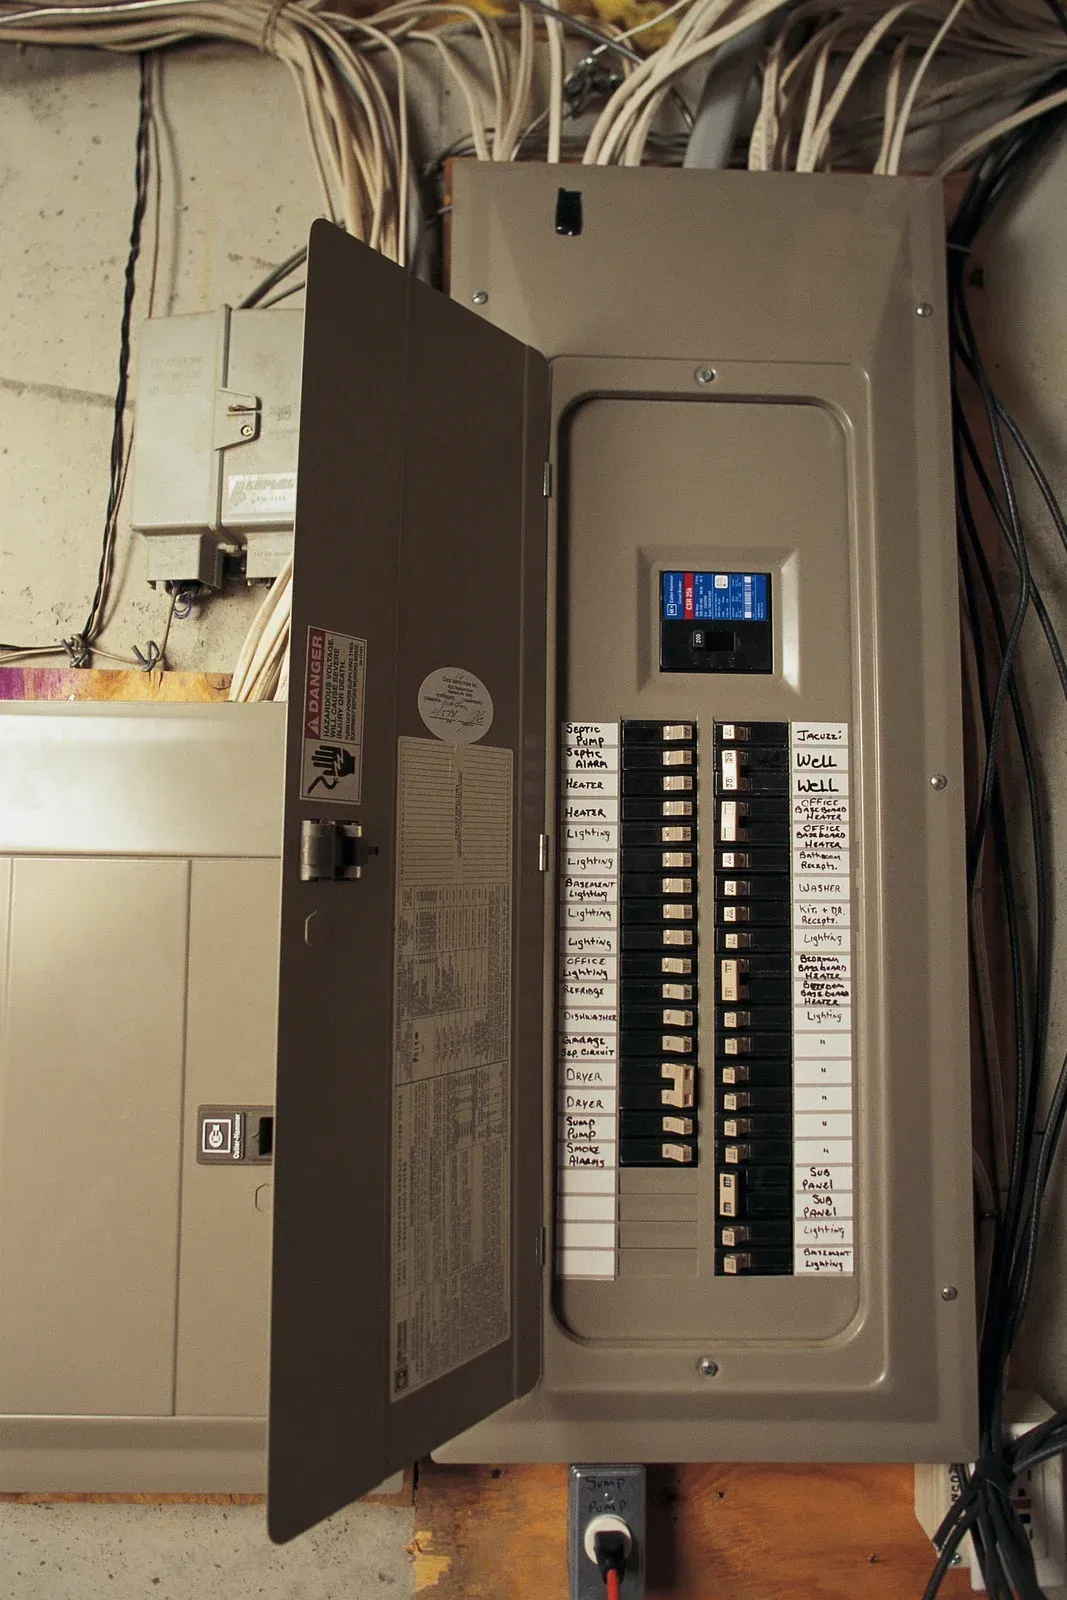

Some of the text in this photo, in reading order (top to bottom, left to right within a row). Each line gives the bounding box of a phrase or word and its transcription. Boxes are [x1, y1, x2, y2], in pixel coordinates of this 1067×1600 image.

[685, 598, 693, 610] CSR
[332, 647, 340, 683] SEVERE
[308, 635, 323, 713] DANGER
[323, 637, 334, 737] HAZARDOUS VOLTAGE.
[338, 693, 344, 706] OR
[576, 736, 604, 748] PUMP
[726, 752, 732, 762] 20
[797, 752, 837, 768] Well
[575, 759, 608, 769] ALARM
[565, 777, 604, 790] HEATER
[727, 778, 733, 788] 20
[798, 778, 839, 792] Well
[801, 797, 838, 807] OFFICE
[565, 807, 606, 818] HEATER
[806, 813, 842, 821] HEATER
[803, 824, 841, 832] OFFICE
[567, 828, 610, 841] Lighting
[804, 840, 842, 849] HEATER
[567, 856, 614, 870] Lighting
[565, 878, 616, 888] BASEMENT
[799, 883, 841, 893] WASHER
[569, 889, 608, 901] Lighting
[567, 907, 612, 921] Lighting
[568, 936, 612, 951] Lighting
[804, 932, 842, 947] Lighting
[566, 957, 606, 966] OFFICE
[562, 967, 608, 981] Lighting
[805, 972, 842, 980] HEATER
[804, 997, 840, 1006] HEATER
[563, 1011, 617, 1021] DISHWASHER
[807, 1010, 842, 1023] Lighting
[562, 1036, 606, 1048] GARAGE
[581, 1047, 615, 1056] CIRCUIT
[566, 1067, 602, 1083] DRYER
[566, 1096, 604, 1109] DRYER
[566, 1116, 596, 1130] SUMP
[567, 1128, 596, 1141] PUMP
[566, 1142, 600, 1154] SMOKE
[568, 1155, 605, 1167] ALARMS
[810, 1167, 831, 1177] SUB
[802, 1179, 833, 1190] PANEL
[812, 1194, 833, 1206] SUB
[803, 1207, 837, 1219] PANEL
[804, 1225, 845, 1239] Lighting
[804, 1248, 851, 1257] BASEMENT
[805, 1260, 843, 1272] Lighting
[585, 1476, 626, 1492] SUMP
[588, 1498, 627, 1513] PUMP
